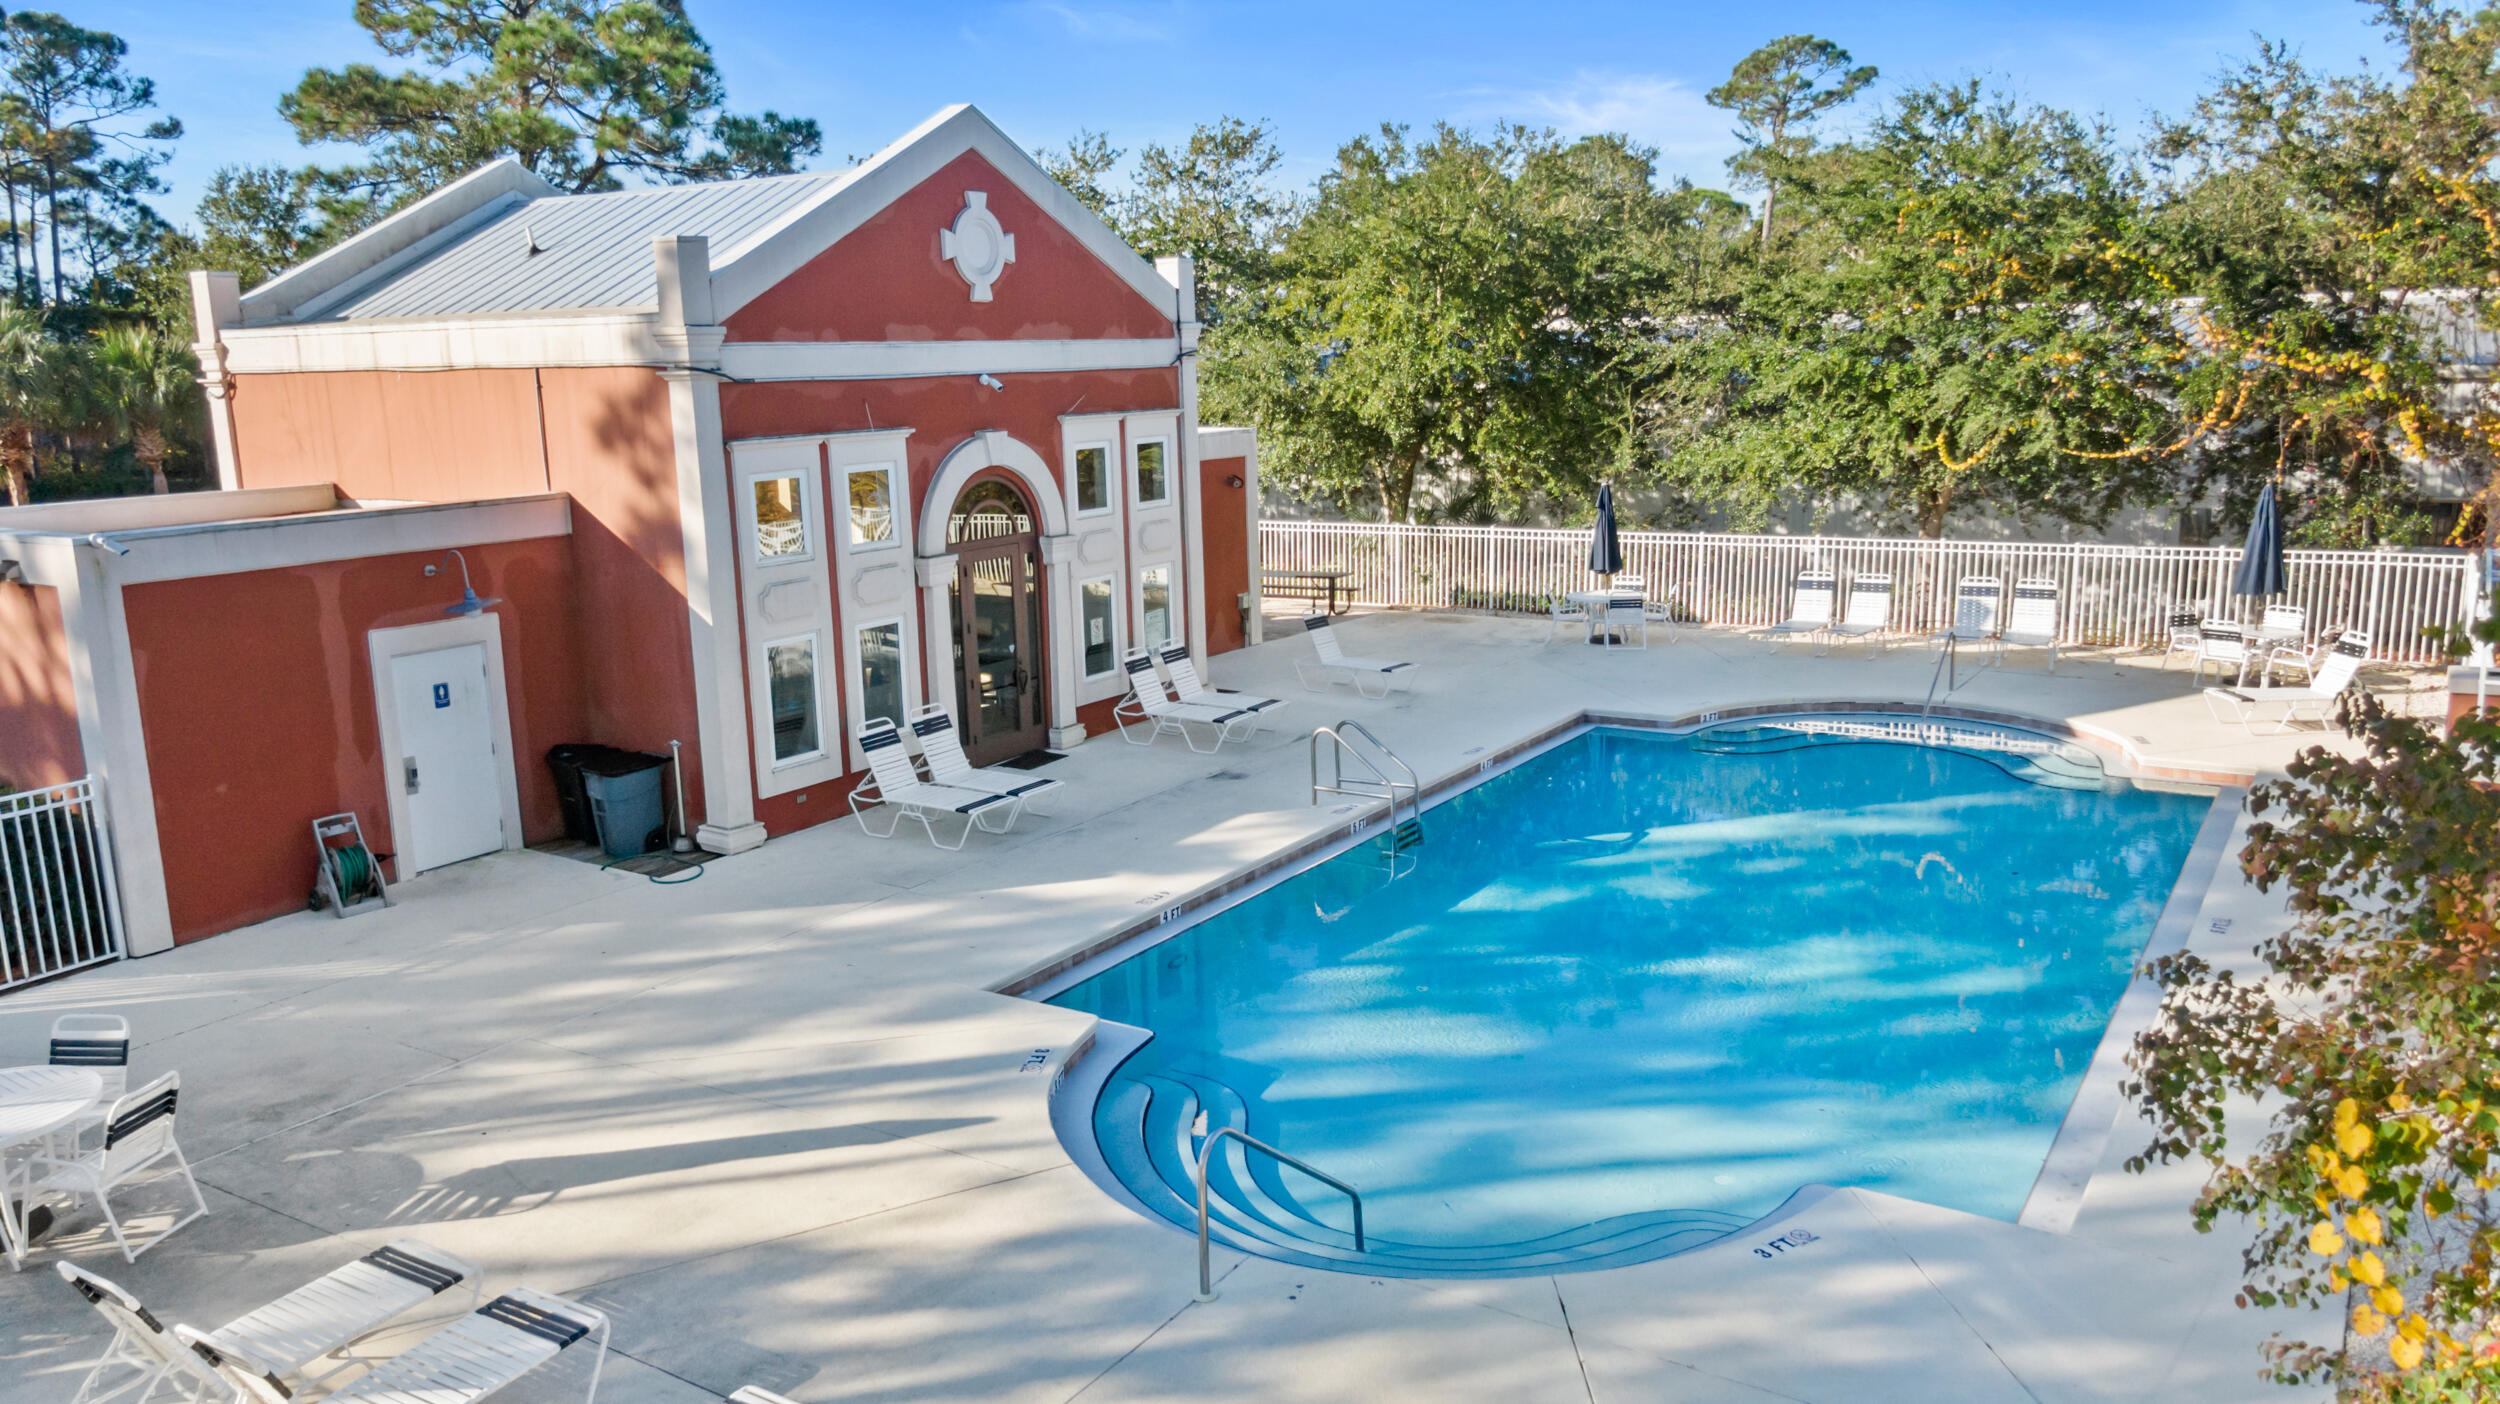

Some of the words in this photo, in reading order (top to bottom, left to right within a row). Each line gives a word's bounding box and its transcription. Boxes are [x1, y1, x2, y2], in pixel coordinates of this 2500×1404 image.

[1163, 911, 1168, 923] 4
[1170, 906, 1180, 919] FT
[1027, 1055, 1047, 1064] FT
[1753, 1248, 1773, 1259] 3
[1768, 1237, 1797, 1252] FT
